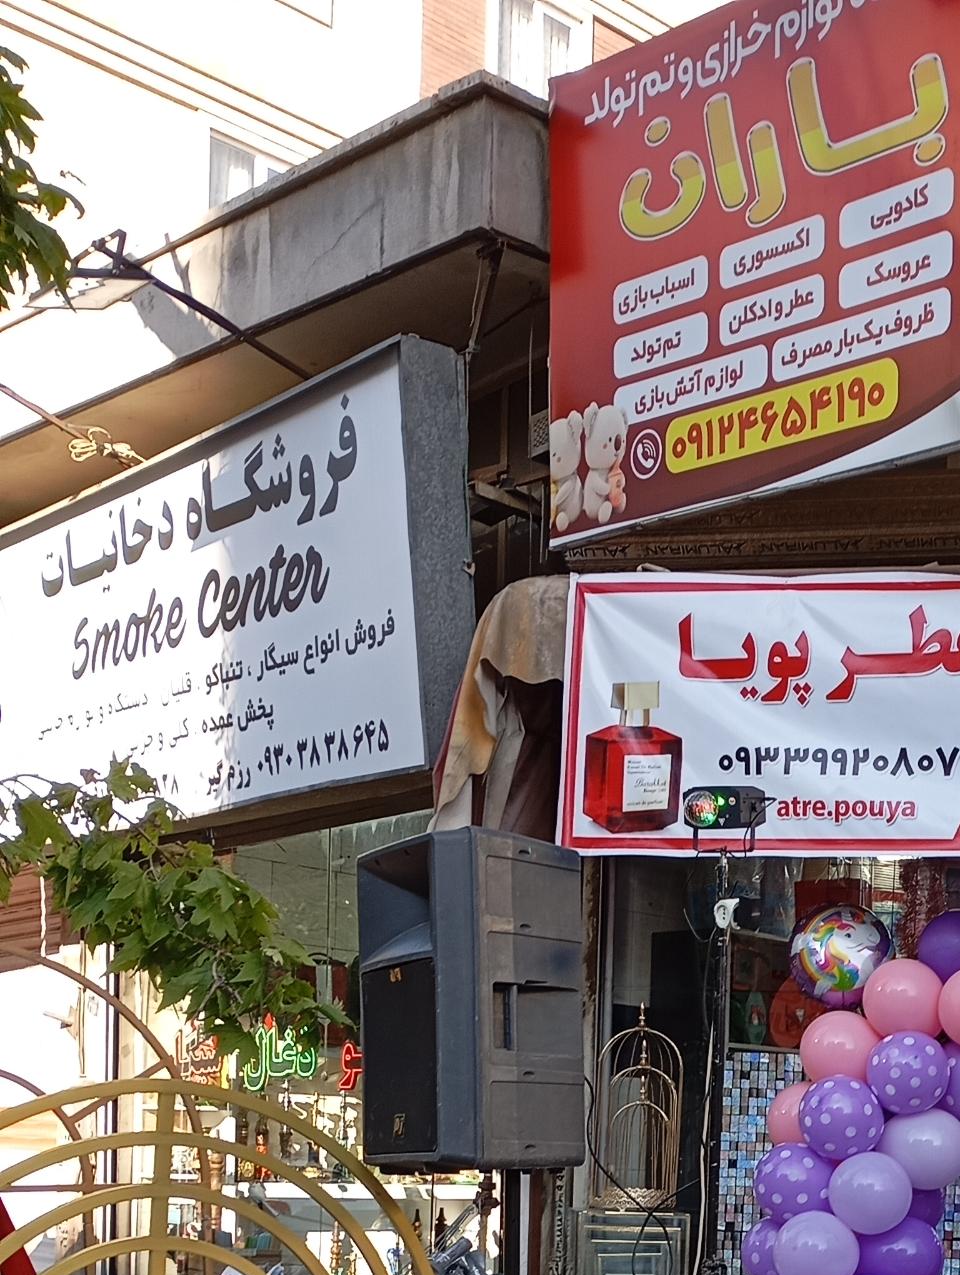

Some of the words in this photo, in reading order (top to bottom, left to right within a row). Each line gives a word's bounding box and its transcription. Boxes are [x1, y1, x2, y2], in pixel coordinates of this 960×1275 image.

[697, 9, 771, 88] خرازی
[638, 52, 675, 116] تم
[678, 56, 693, 99] و
[584, 69, 637, 128] تولد
[618, 52, 950, 241] باران
[871, 183, 929, 229] کادویی
[733, 227, 810, 276] اکسسوری
[650, 268, 695, 304] اسباب
[866, 255, 931, 286] عروسک
[618, 285, 648, 315] بازی
[729, 299, 772, 334] ادکلن
[774, 301, 783, 321] و
[784, 288, 814, 318] عطر
[856, 319, 883, 345] یک
[885, 302, 935, 337] ظروف
[630, 338, 661, 363] تولد
[663, 331, 681, 358] تم
[781, 340, 833, 368] مصرف
[834, 328, 855, 358] بار
[666, 368, 703, 405] آتش
[704, 360, 743, 395] لوازم
[635, 386, 665, 415] بازی
[671, 376, 886, 461] ۰۹۱۲۴۶۵۴۱۹۰
[186, 394, 358, 541] فروشگاه
[41, 498, 174, 598] دخانیات
[72, 588, 187, 680] Smoke
[198, 544, 330, 638] Center
[345, 608, 395, 655] فروش
[257, 642, 299, 681] سیگار
[304, 629, 340, 674] انواع
[677, 611, 811, 706] پویا
[205, 659, 243, 695] تنباکو
[202, 713, 233, 733] عمده
[237, 698, 274, 731] پخش
[776, 795, 917, 823] atre.pouya
